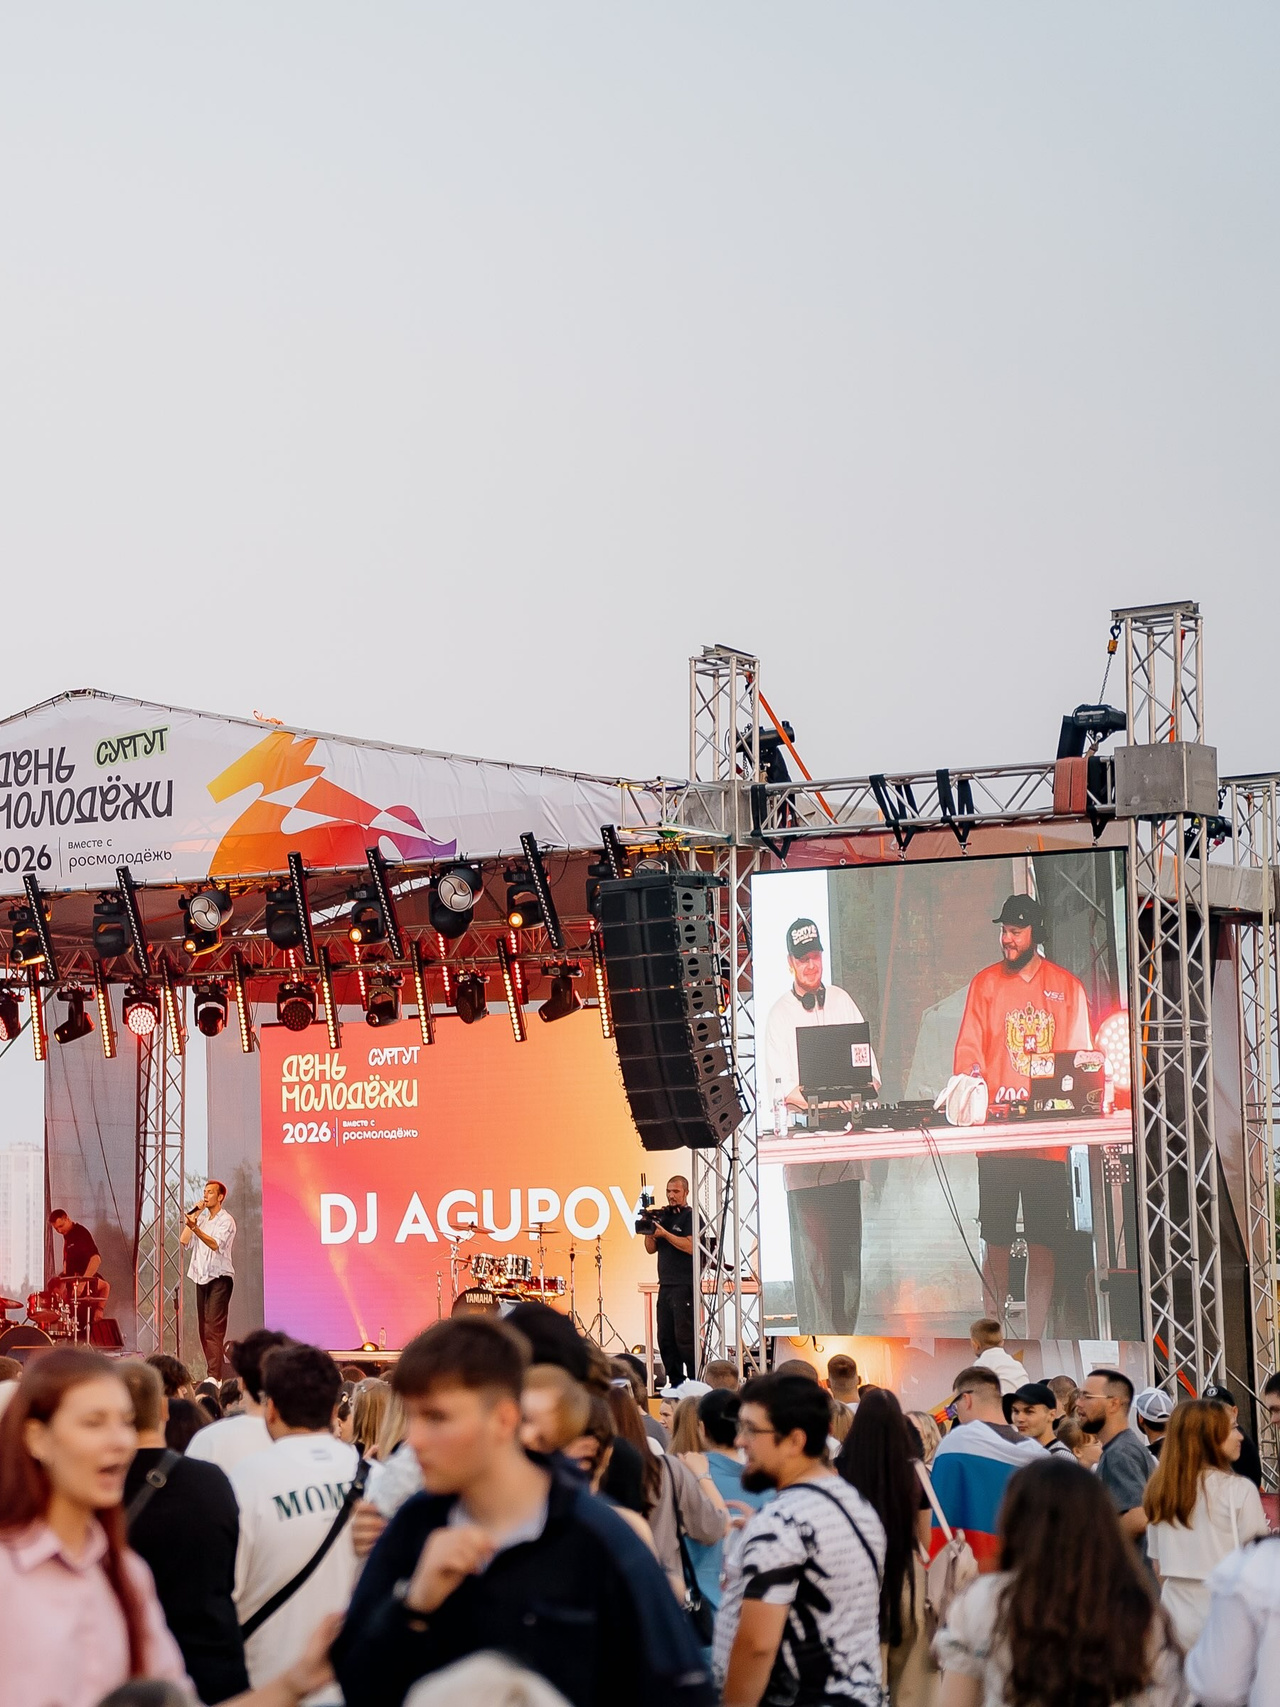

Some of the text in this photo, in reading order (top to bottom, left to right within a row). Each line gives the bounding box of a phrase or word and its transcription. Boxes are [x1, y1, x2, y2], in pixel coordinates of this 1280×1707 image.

[95, 727, 169, 766] СУРГУТ
[67, 838, 113, 849] вместе с
[68, 849, 173, 872] росмолодёжь
[367, 1046, 421, 1067] СУРГУТ
[282, 1122, 331, 1143] 2026
[342, 1119, 369, 1127] вместе
[342, 1127, 419, 1144] росмолодёжь
[320, 1191, 378, 1245] DJ
[465, 1293, 493, 1304] YAMAHA
